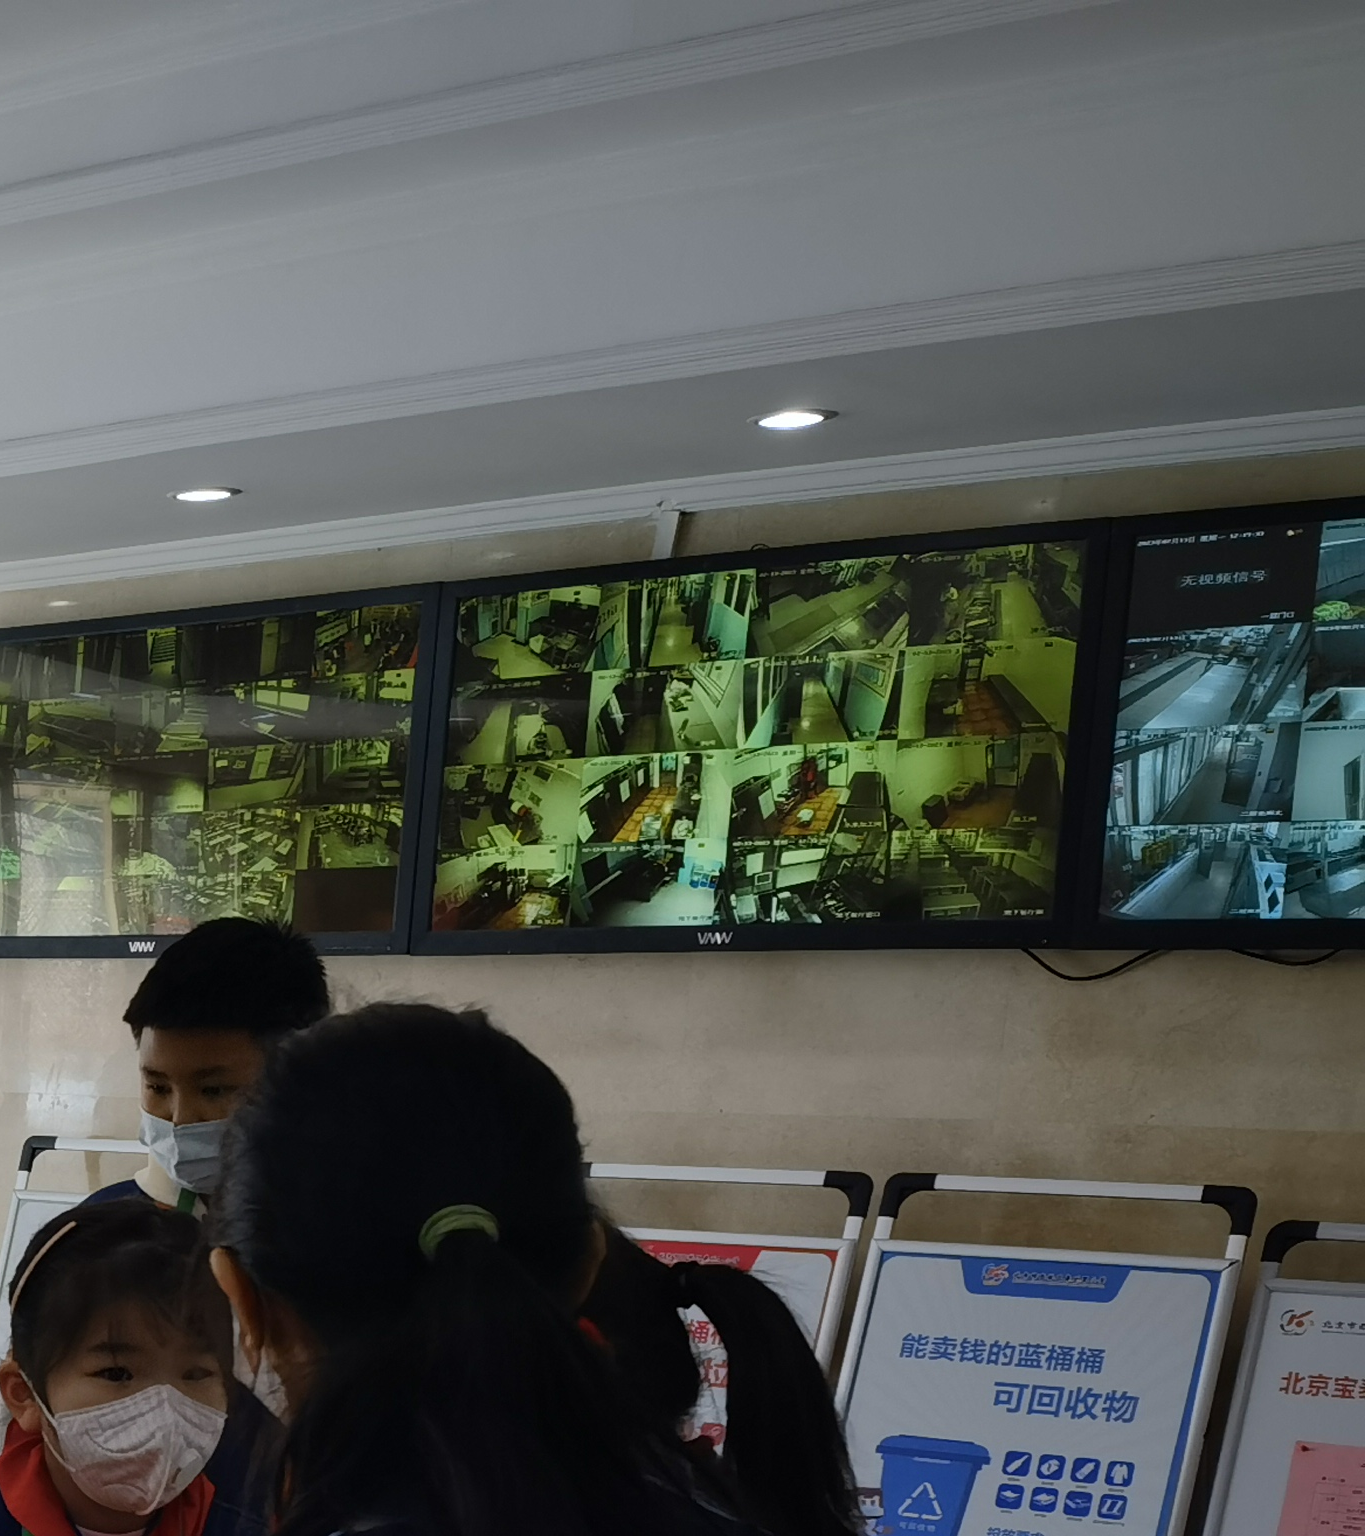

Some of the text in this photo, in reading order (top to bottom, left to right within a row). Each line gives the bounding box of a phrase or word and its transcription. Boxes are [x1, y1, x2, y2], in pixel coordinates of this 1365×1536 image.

[1179, 569, 1268, 588] 无视频信号
[899, 1332, 1107, 1375] 能卖钱的蓝桶桶
[992, 1381, 1140, 1424] 可回收物
[1278, 1371, 1365, 1399] 北京宝
